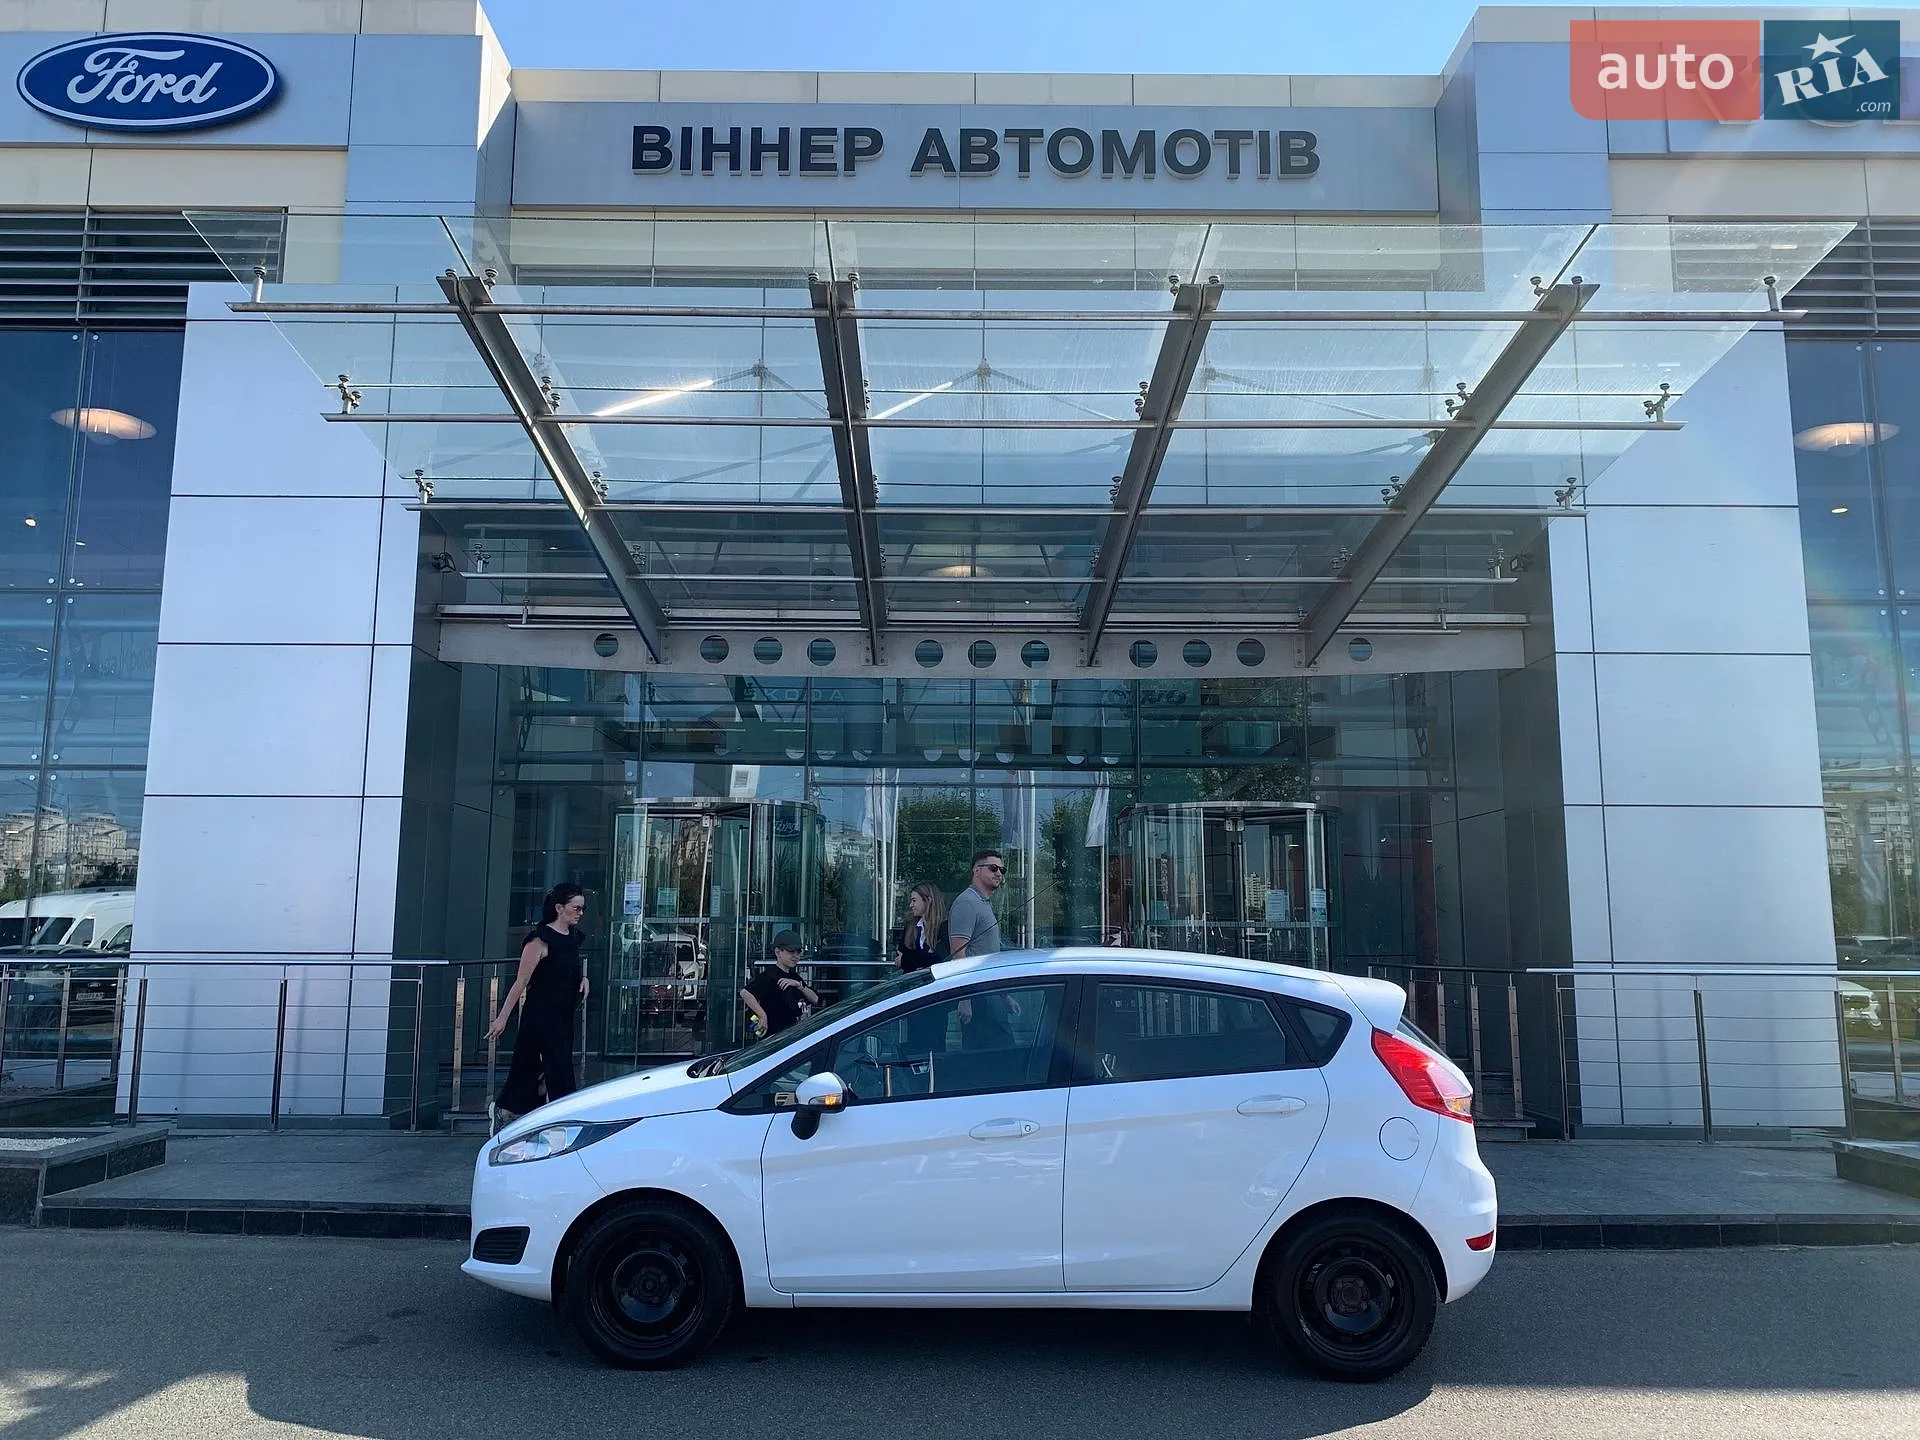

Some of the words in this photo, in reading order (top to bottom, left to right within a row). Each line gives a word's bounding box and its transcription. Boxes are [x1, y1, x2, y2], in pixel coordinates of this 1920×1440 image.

[66, 47, 223, 104] Ford
[632, 125, 884, 176] ВІННЕР
[910, 127, 1321, 179] АВТОМОТІВ
